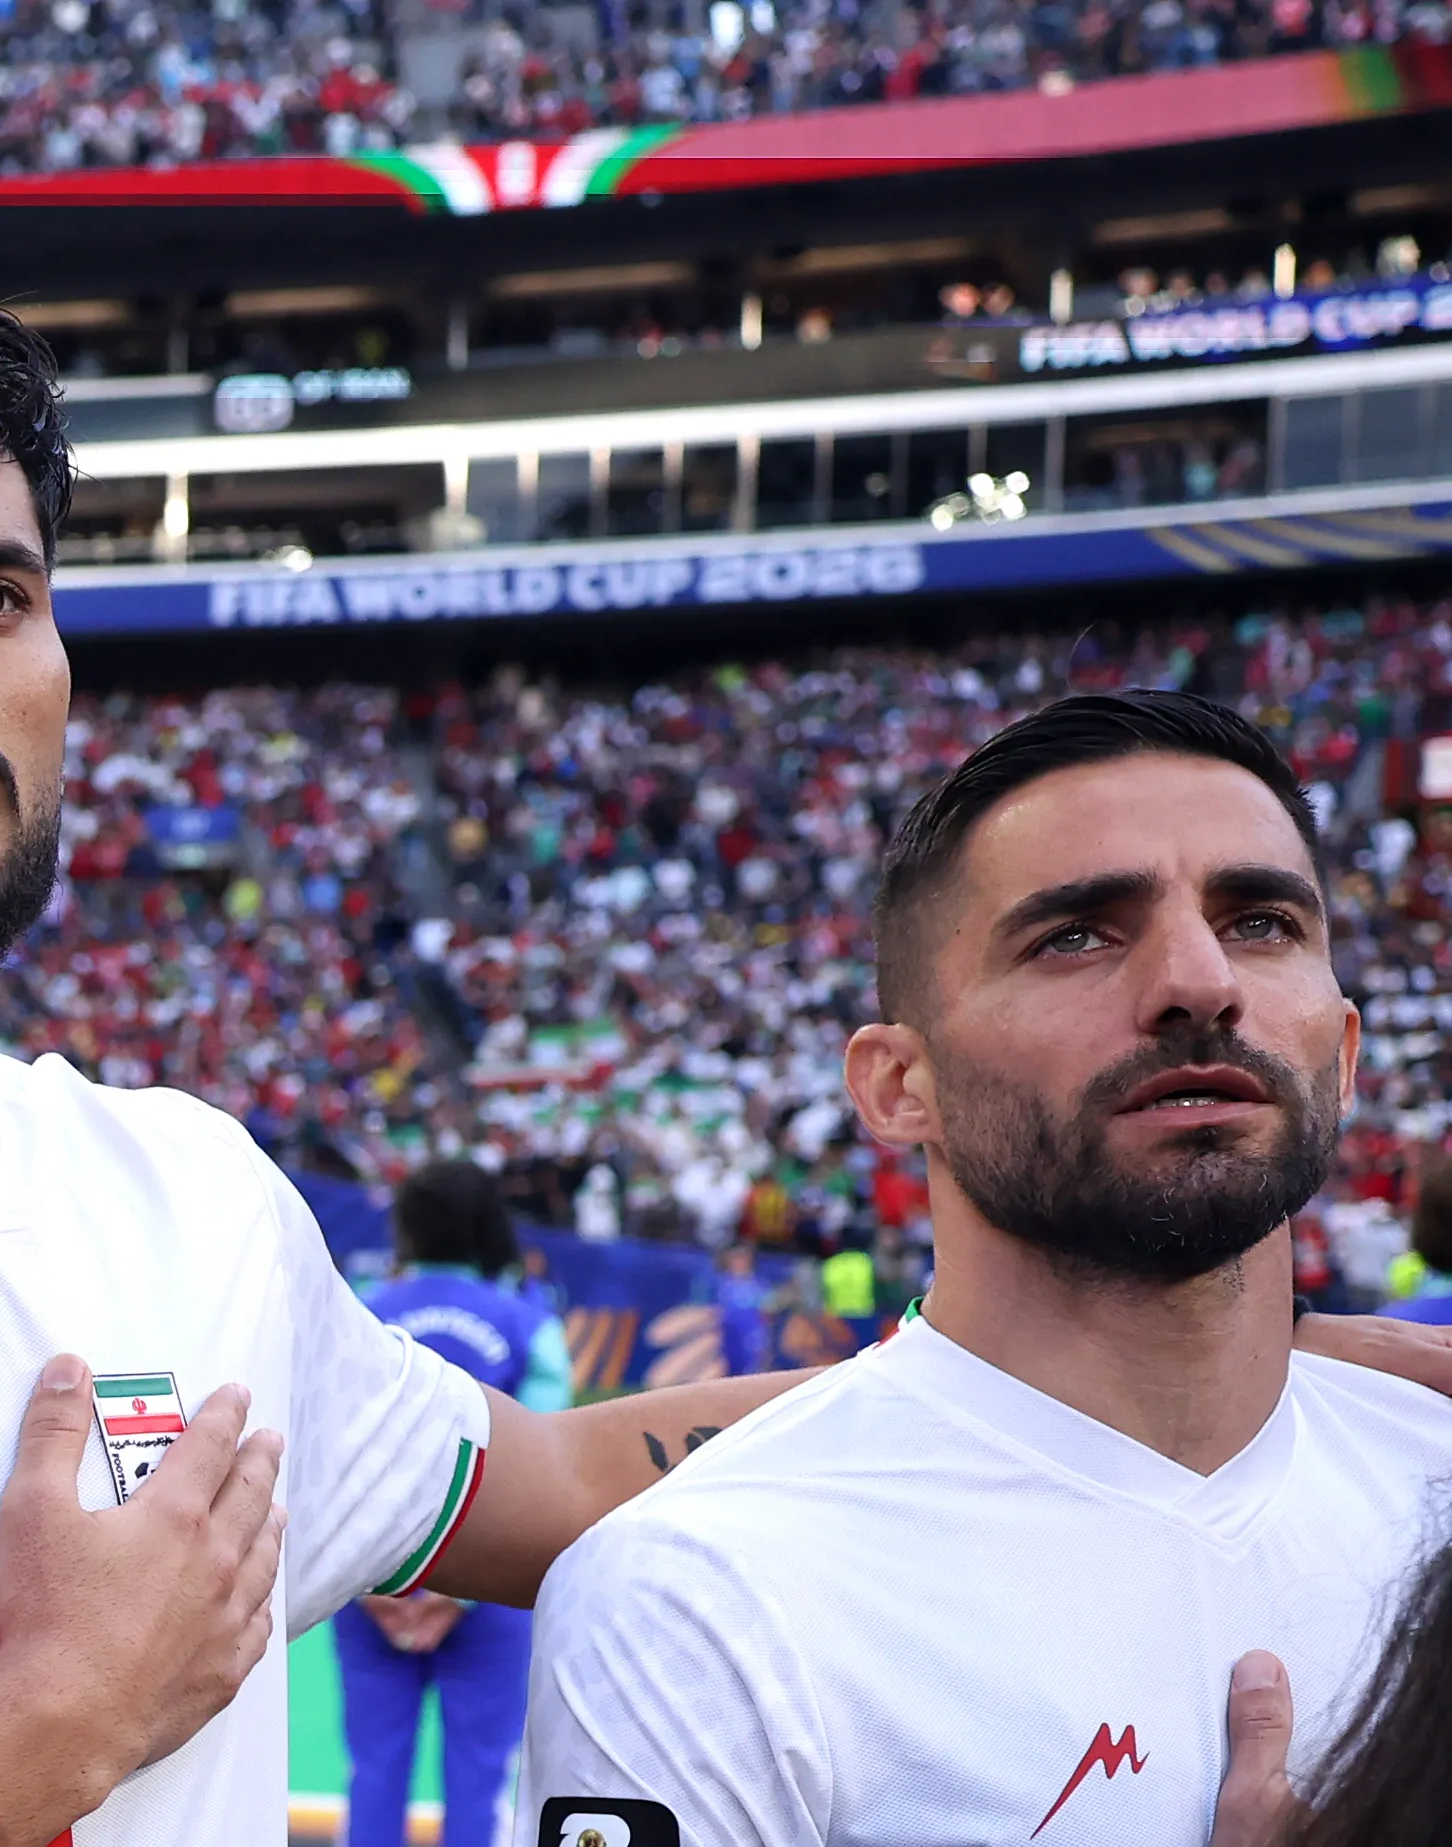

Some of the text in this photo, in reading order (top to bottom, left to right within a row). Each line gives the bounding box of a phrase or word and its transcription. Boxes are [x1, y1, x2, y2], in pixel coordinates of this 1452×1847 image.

[1021, 322, 1130, 371] FIFA
[1129, 302, 1312, 359] WORLD
[1313, 289, 1419, 340] CUP
[209, 545, 926, 626] FIFA WORLD CUP 2026
